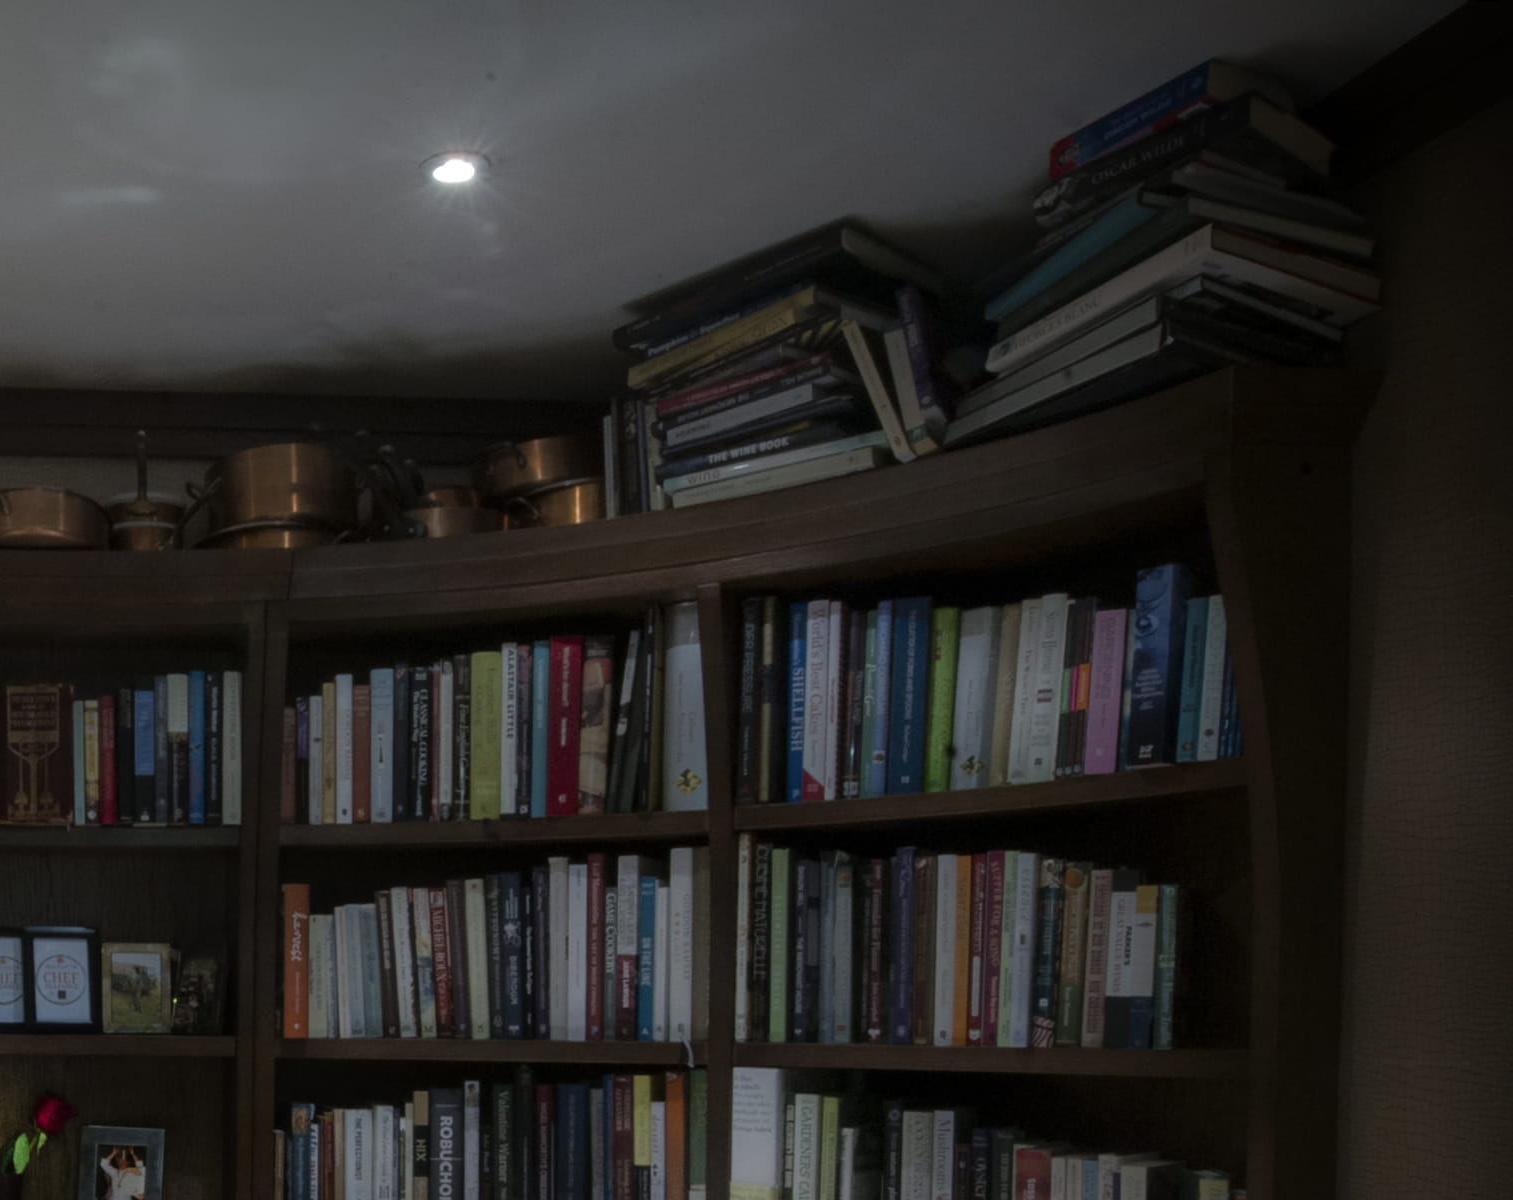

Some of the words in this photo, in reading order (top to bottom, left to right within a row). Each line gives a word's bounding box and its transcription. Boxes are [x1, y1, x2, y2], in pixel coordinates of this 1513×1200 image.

[708, 450, 728, 464] THE
[729, 442, 759, 459] WINE
[759, 434, 791, 453] BOOK
[812, 608, 826, 658] World's
[506, 649, 515, 701] ALASTAIR
[742, 651, 755, 713] PRESSURE
[811, 661, 825, 691] Best
[506, 703, 515, 740] LITTLE
[790, 666, 805, 753] SHELLFISH
[809, 694, 824, 737] Cakes
[606, 892, 616, 925] GAME
[290, 910, 308, 963] harvest
[605, 925, 616, 975] COOKERY
[43, 971, 79, 985] CHEF
[415, 1138, 427, 1161] HIX
[498, 1141, 510, 1184] Warner
[798, 1105, 812, 1178] GARDENERS'
[936, 1119, 951, 1192] Mushrooms
